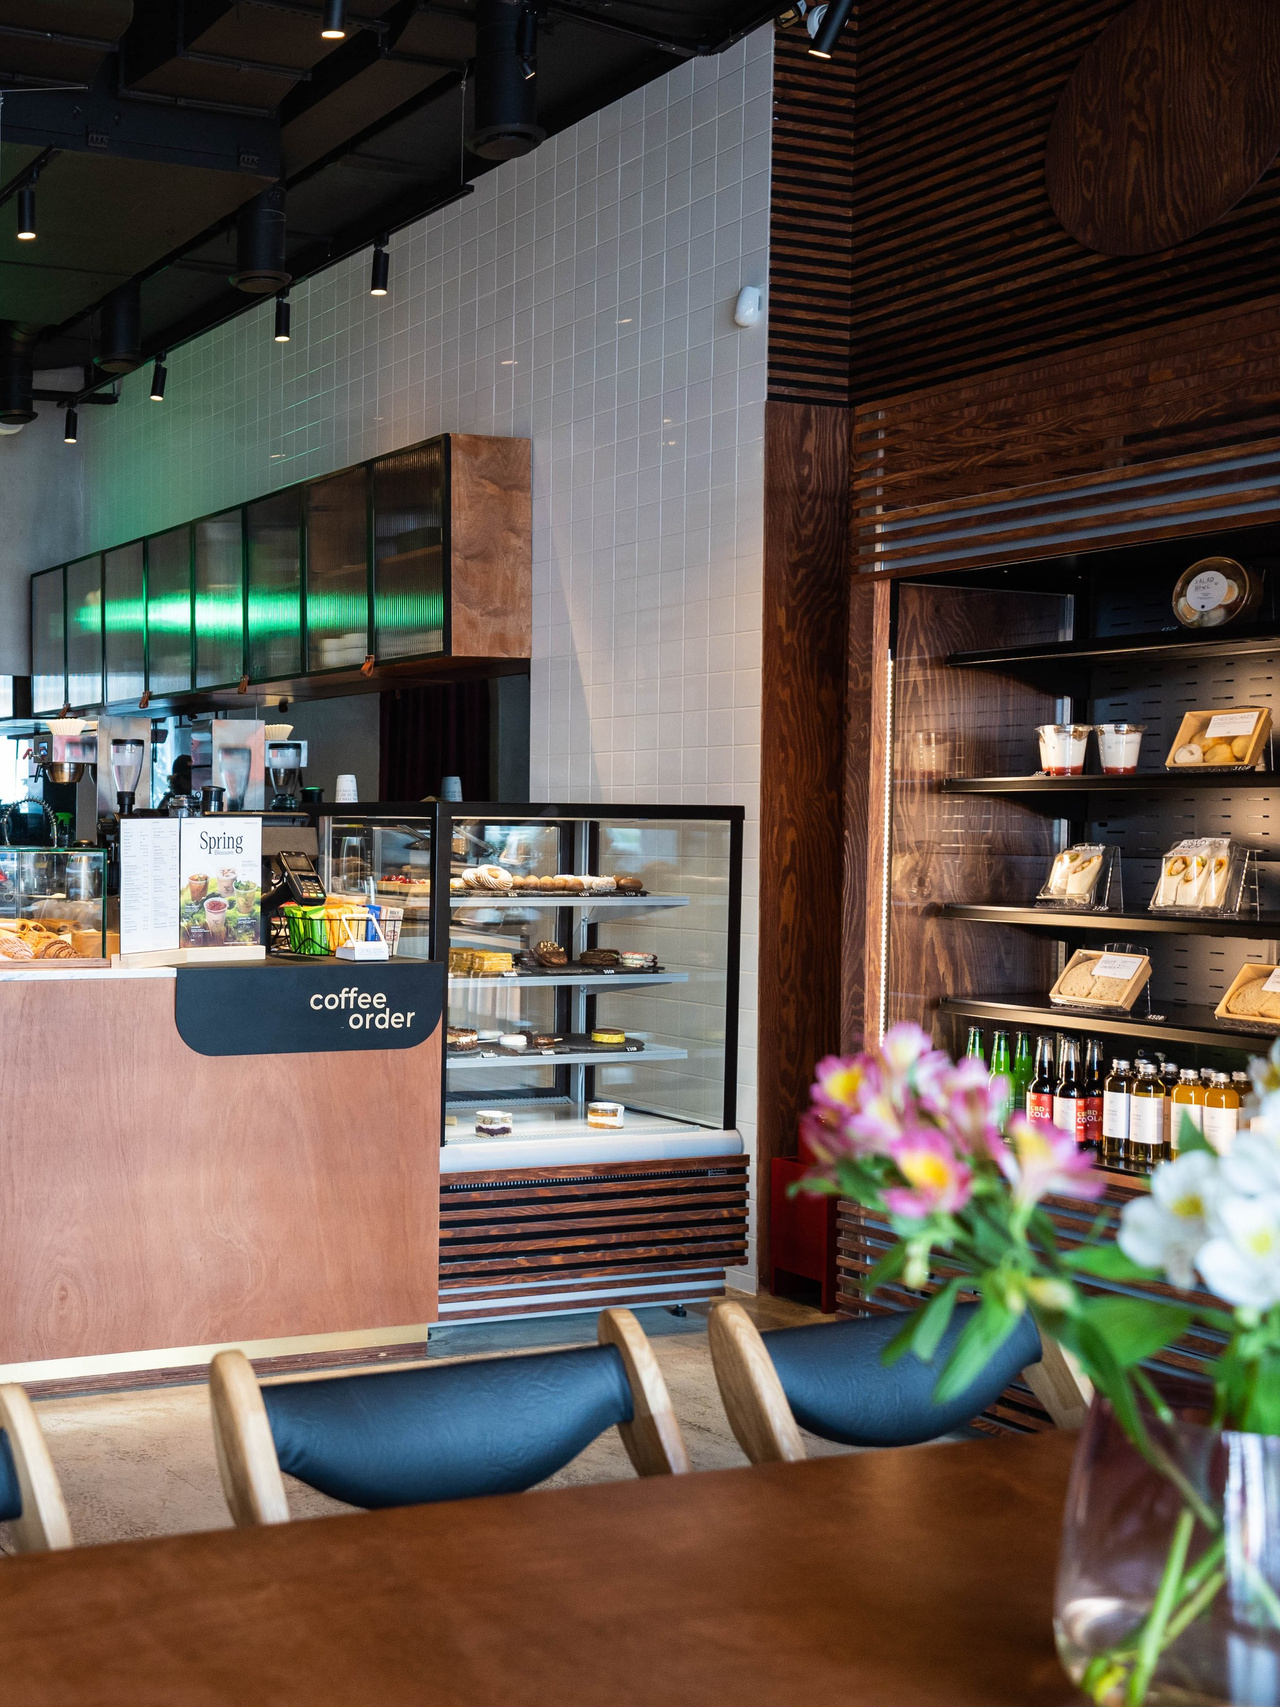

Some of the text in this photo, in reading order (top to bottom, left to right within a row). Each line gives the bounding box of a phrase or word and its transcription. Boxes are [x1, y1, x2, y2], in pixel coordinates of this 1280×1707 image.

[199, 830, 244, 855] Spring
[309, 986, 387, 1011] coffee
[348, 1007, 416, 1030] order
[1030, 1111, 1051, 1119] COLA
